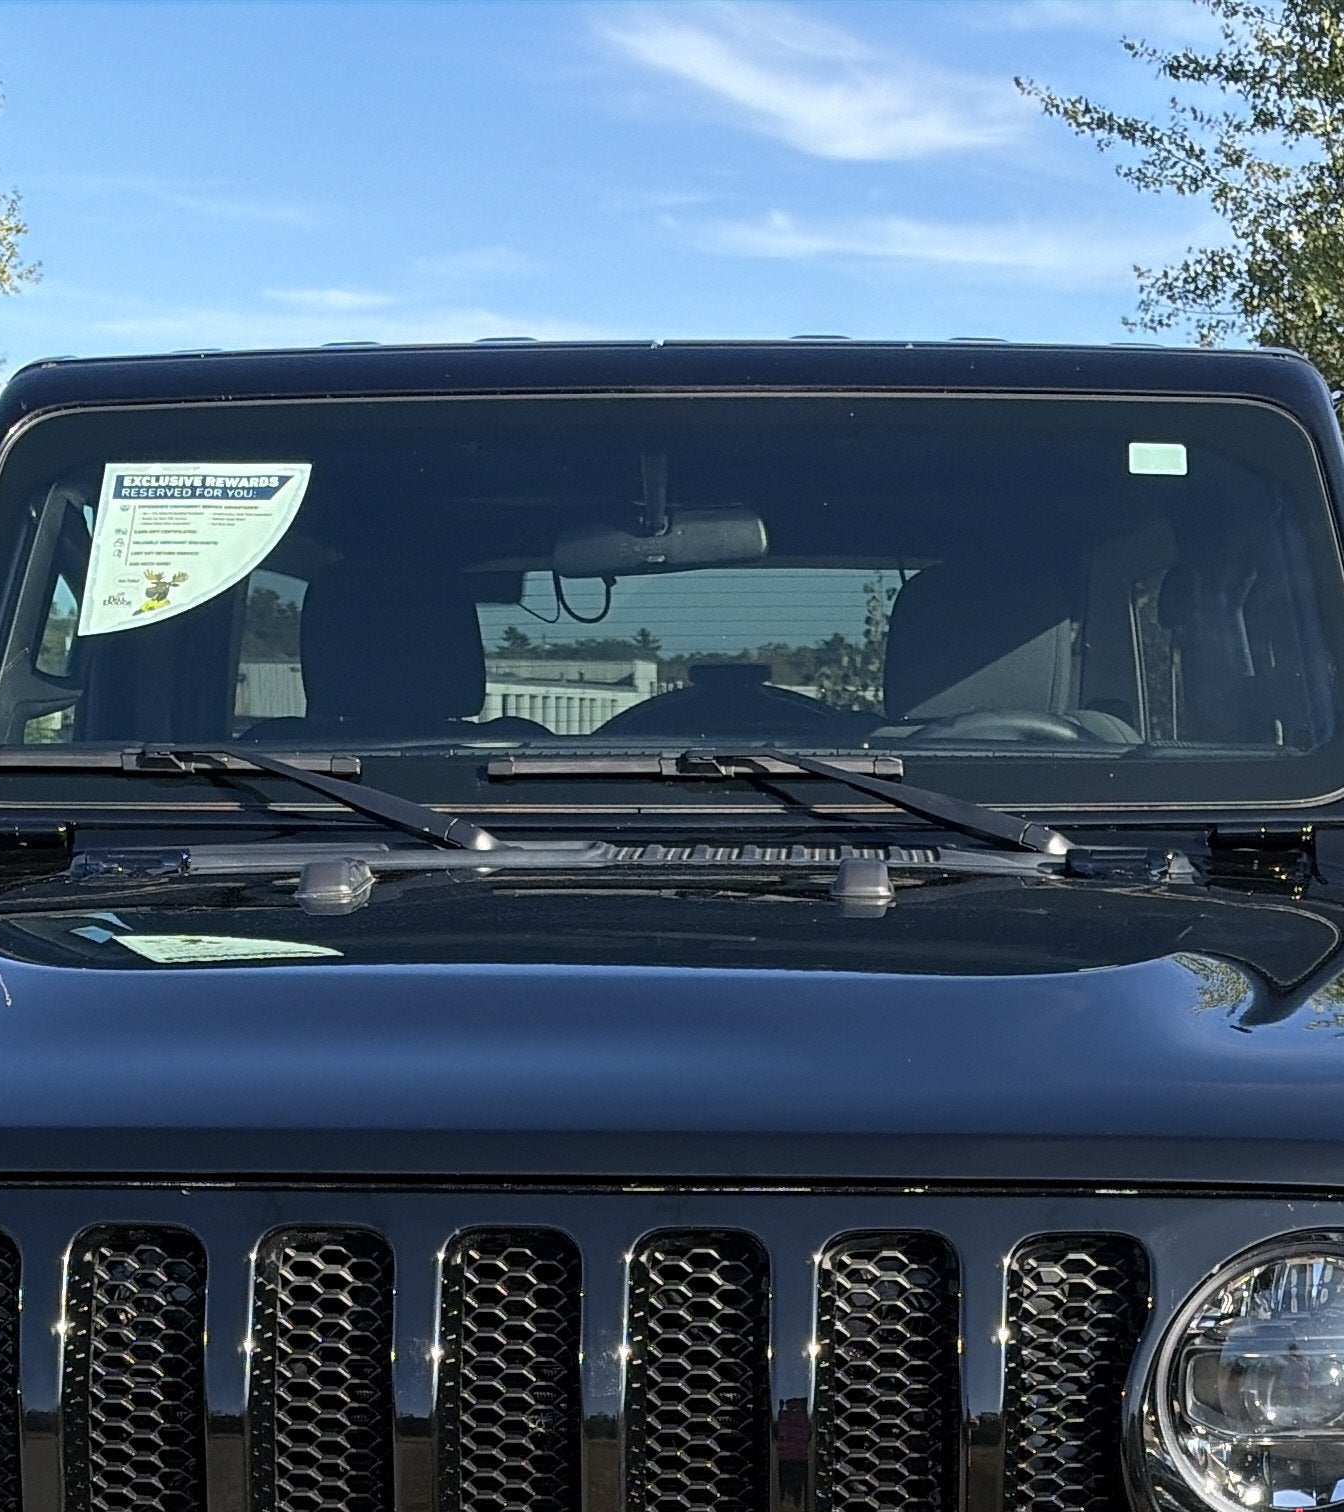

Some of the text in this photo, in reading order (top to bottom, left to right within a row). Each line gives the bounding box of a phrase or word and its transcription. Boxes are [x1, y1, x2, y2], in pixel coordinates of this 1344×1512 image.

[123, 476, 279, 488] EXCLUSIVE REWARDS
[121, 488, 257, 498] RESERVED FOR YOU:
